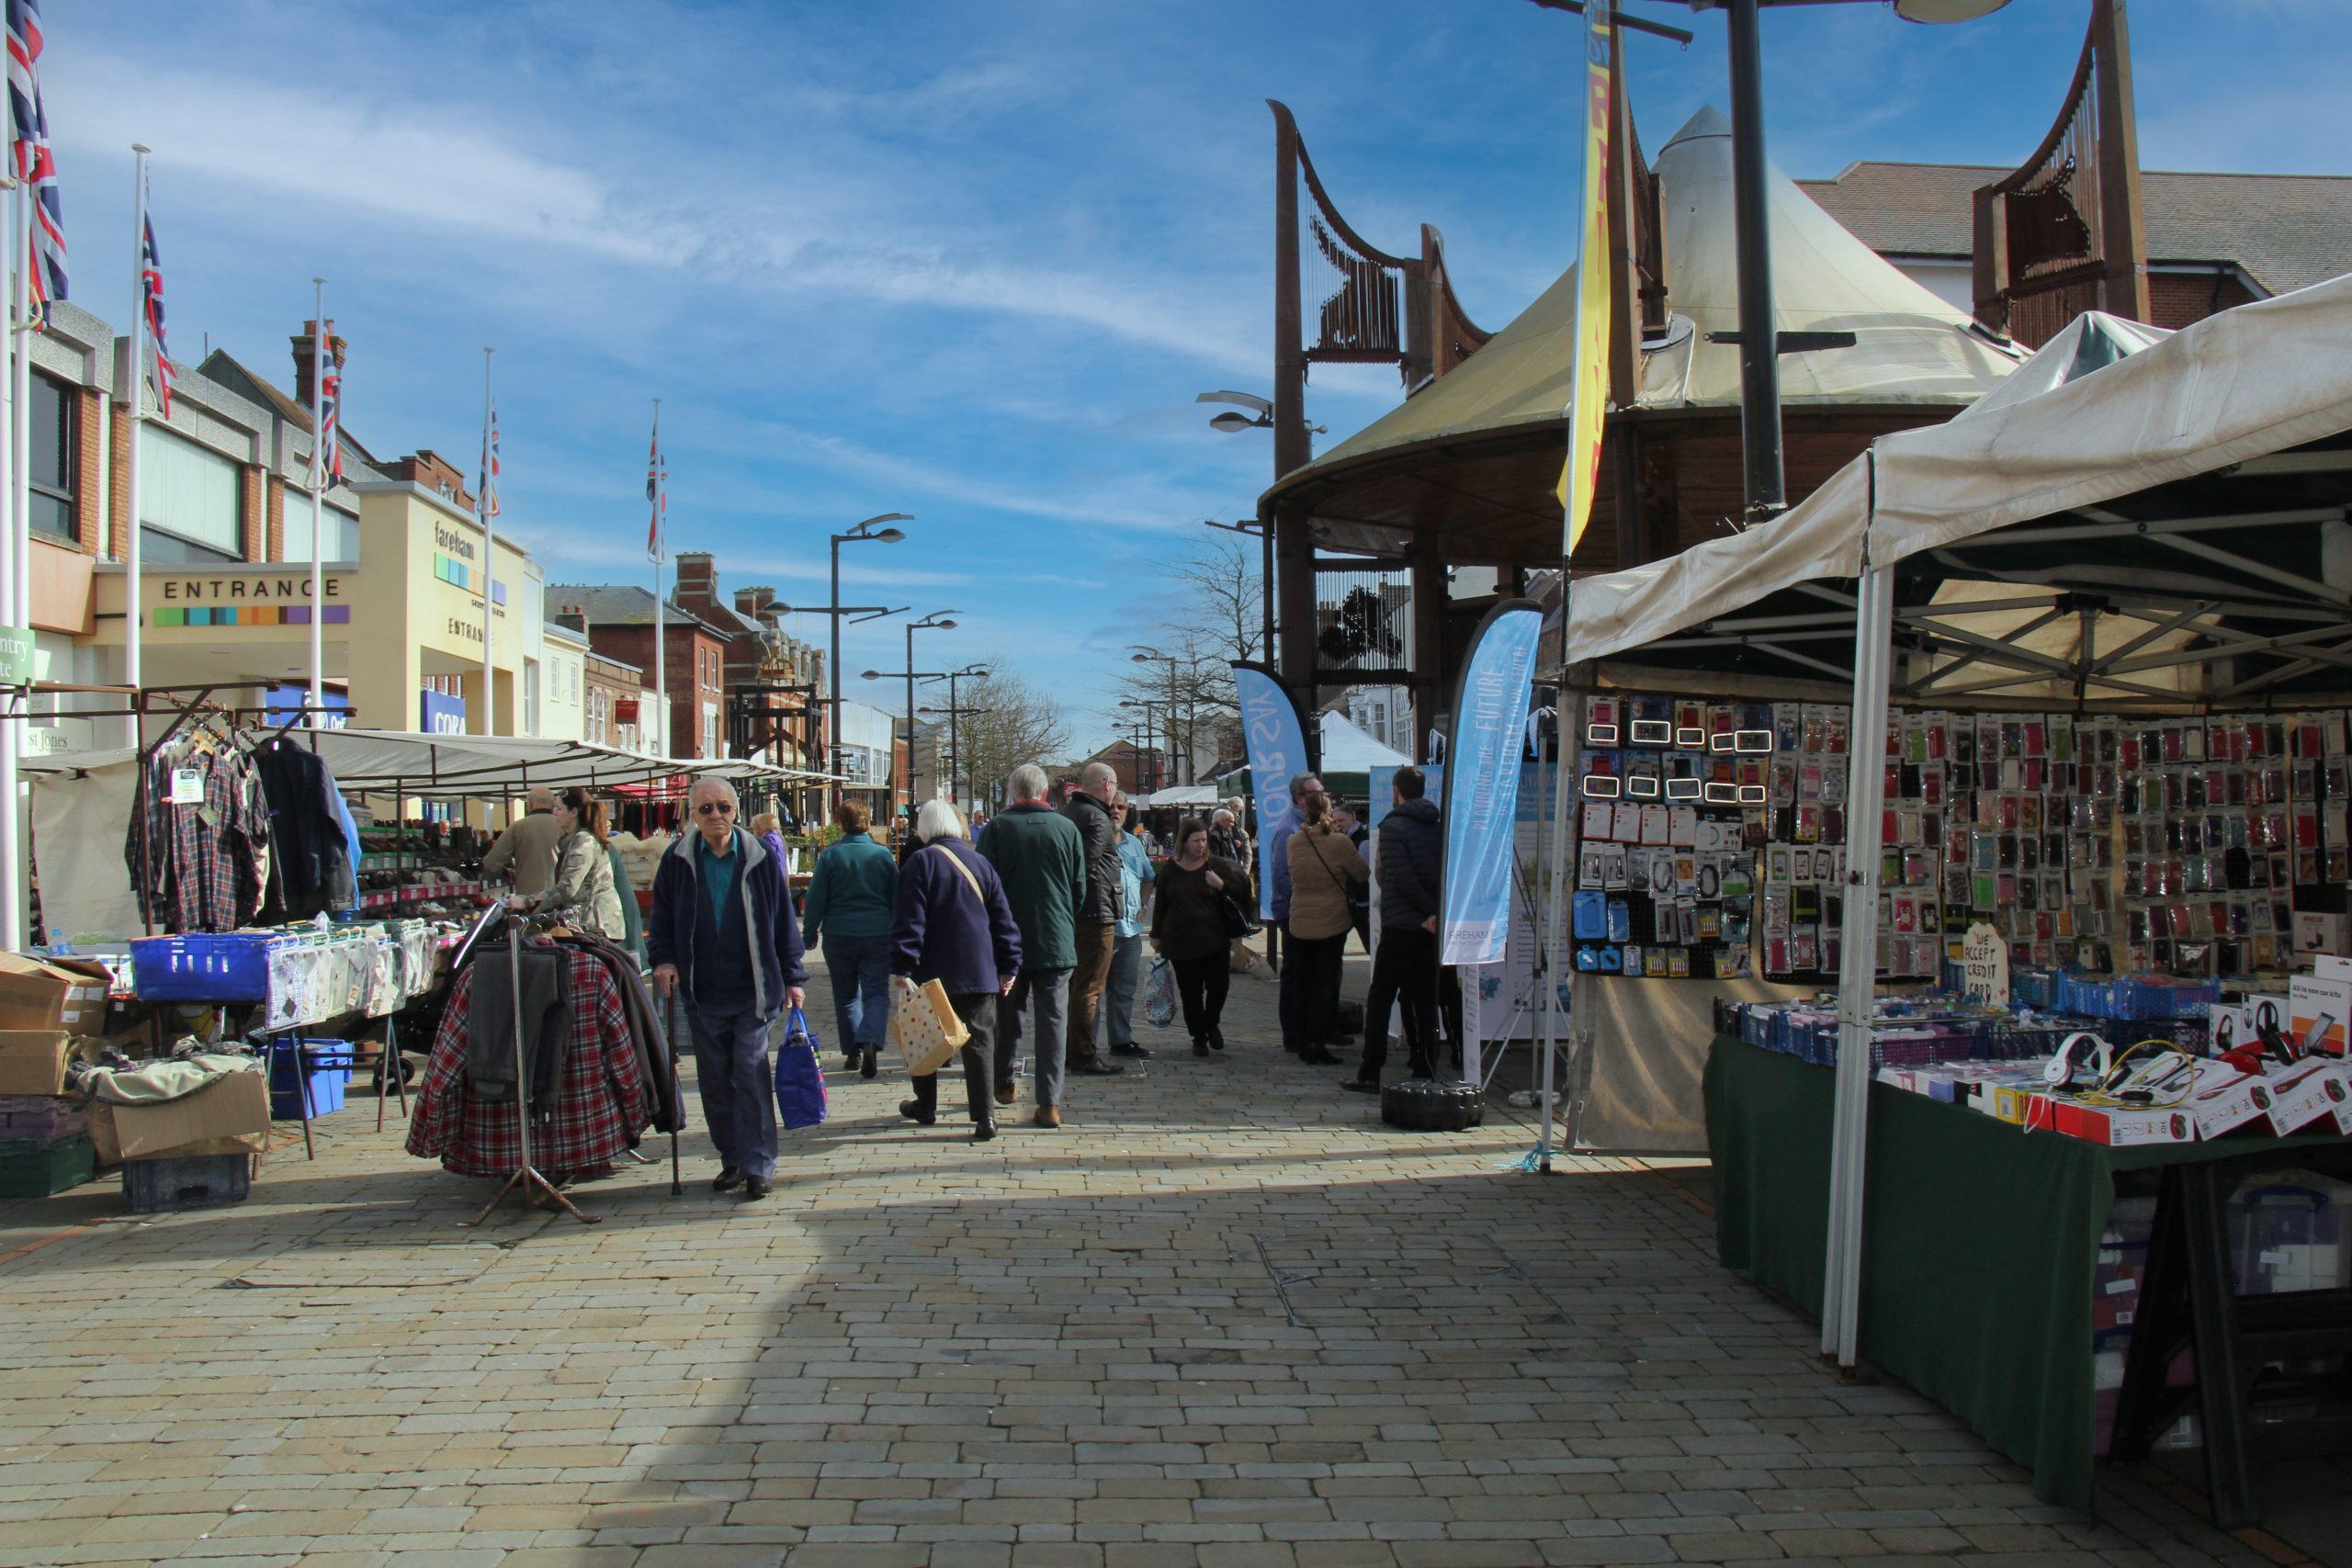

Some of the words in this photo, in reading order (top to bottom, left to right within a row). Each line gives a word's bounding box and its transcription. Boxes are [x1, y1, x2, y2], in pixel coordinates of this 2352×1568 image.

[435, 521, 474, 560] fareham
[164, 579, 339, 599] ENTRANCE
[448, 617, 494, 648] ENTRAN
[1475, 666, 1505, 731] FUTURE
[39, 730, 68, 752] Jones
[1477, 745, 1494, 765] THE
[1498, 724, 1522, 797] FAREHAM
[1472, 771, 1493, 830] PLANNING
[1976, 933, 1990, 945] WE
[1965, 947, 1996, 963] ACCEPT
[1967, 964, 1996, 979] CREDIT
[1969, 982, 1992, 1003] CARD
[2329, 990, 2341, 998] kits
